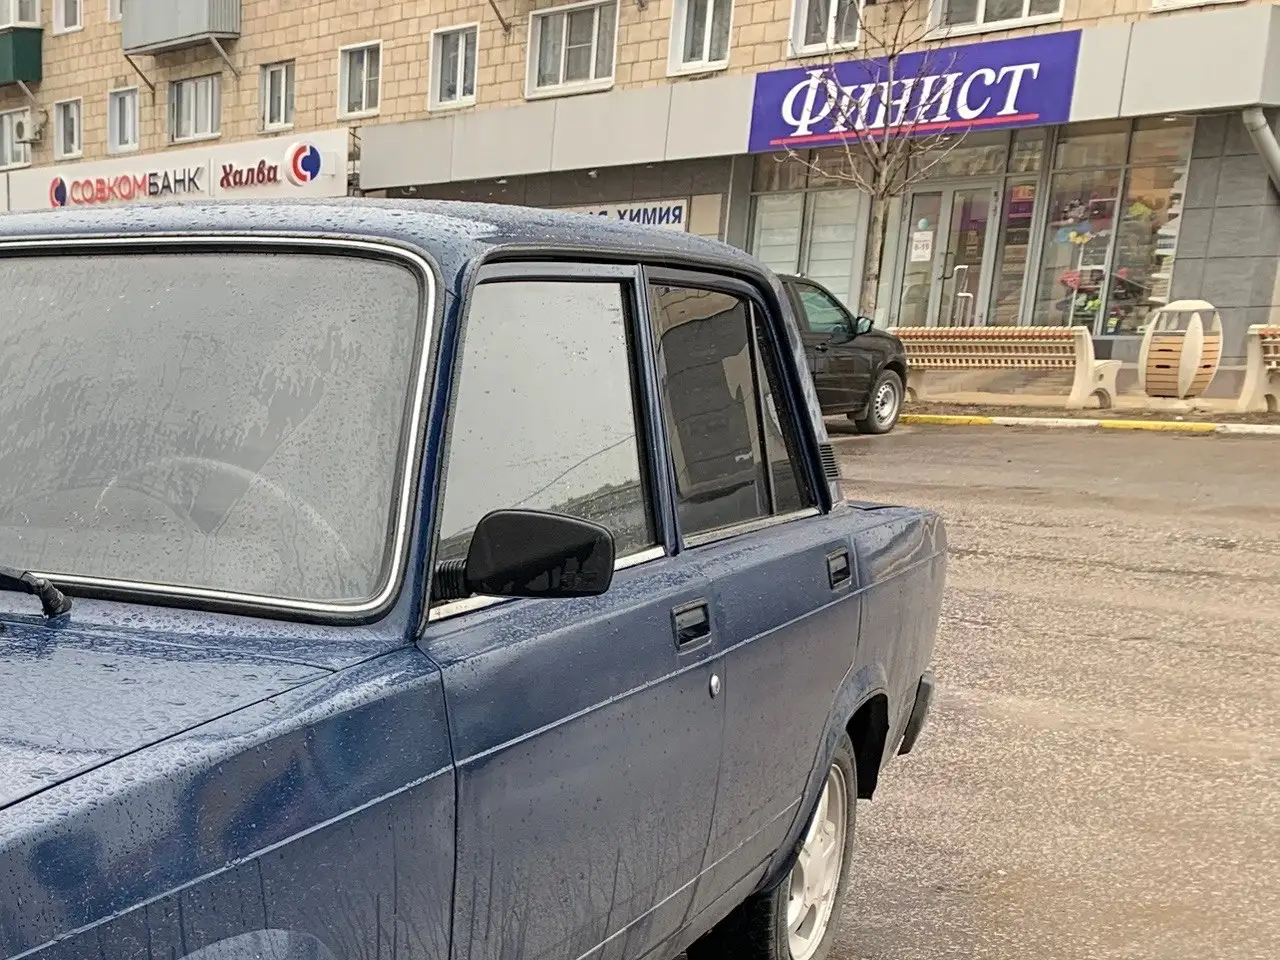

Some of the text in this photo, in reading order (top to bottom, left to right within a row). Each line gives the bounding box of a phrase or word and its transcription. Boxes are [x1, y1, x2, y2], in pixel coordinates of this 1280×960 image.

[782, 63, 1040, 137] ФИНИСТ
[70, 159, 280, 204] СОВКОМБАНК Халва
[617, 206, 682, 225] ХИМИЯ
